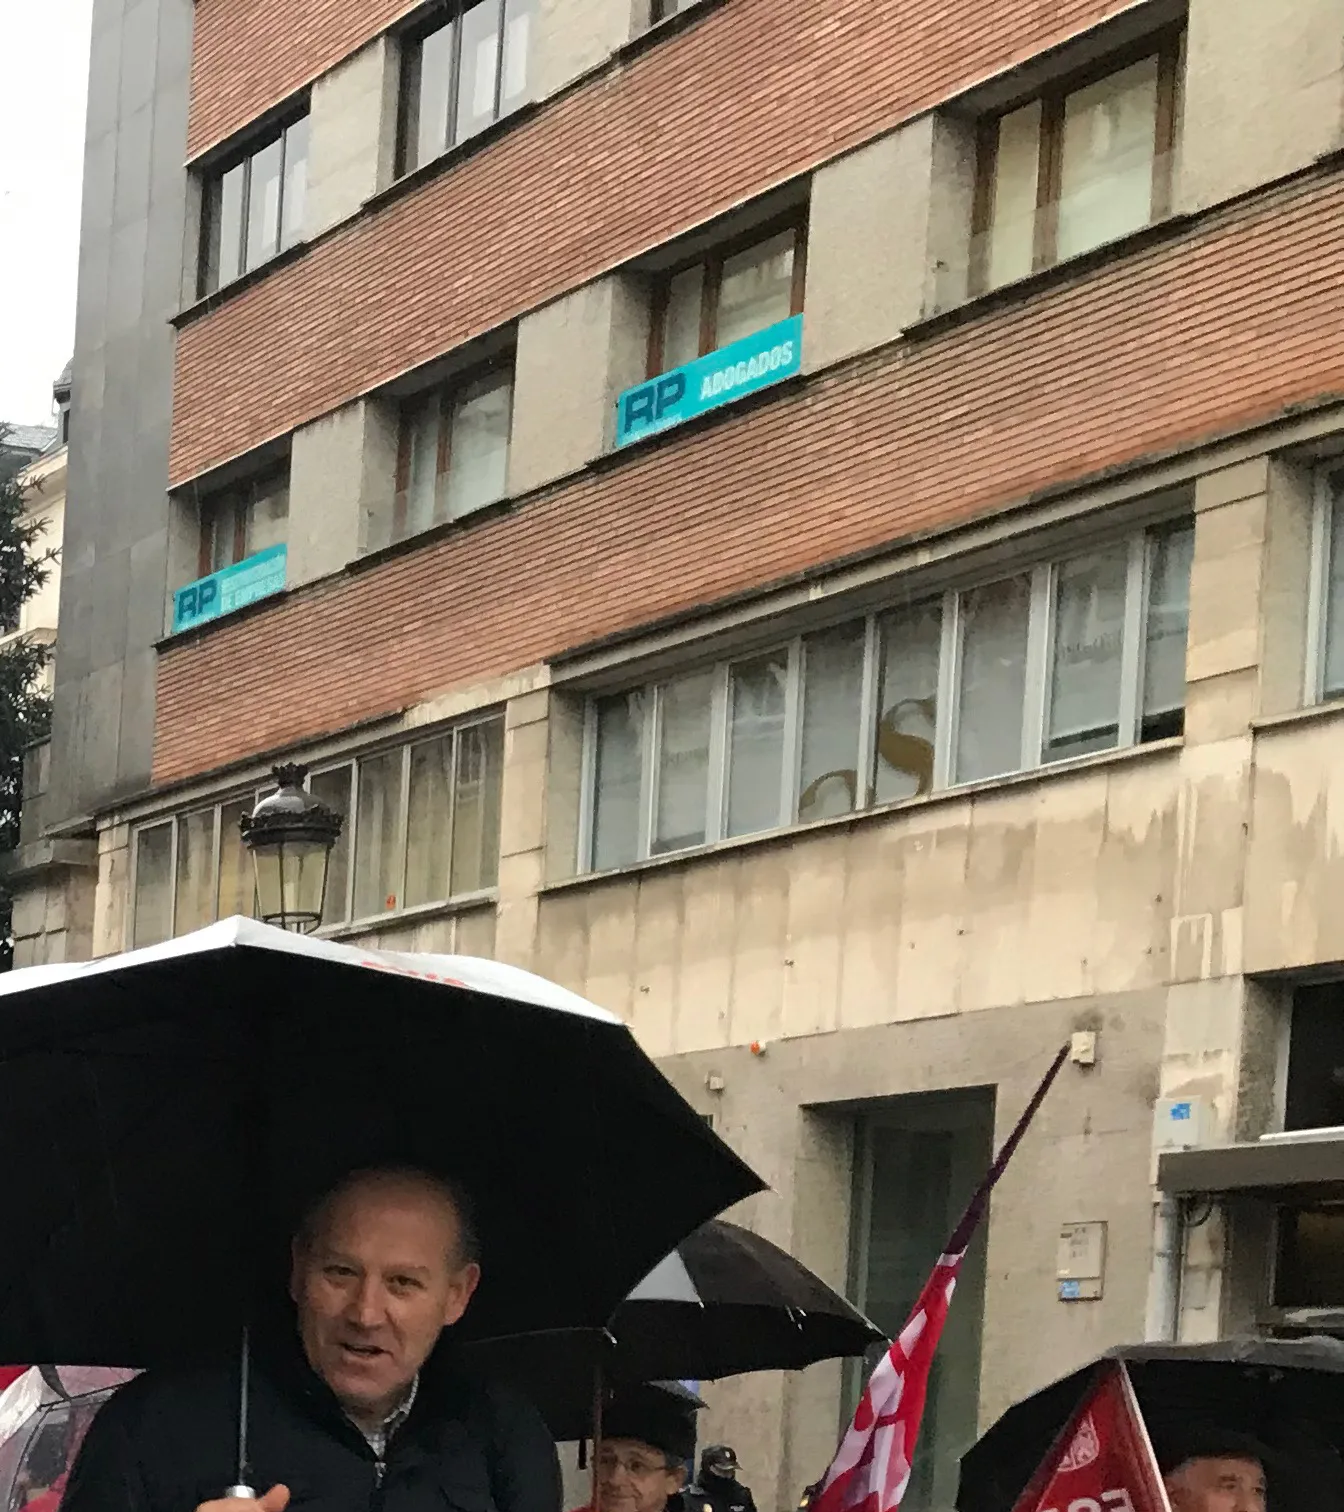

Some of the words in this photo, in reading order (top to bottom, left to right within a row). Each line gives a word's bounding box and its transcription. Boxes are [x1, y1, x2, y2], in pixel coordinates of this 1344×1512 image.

[624, 372, 686, 433] RP
[700, 341, 793, 400] ABOGADOS
[178, 579, 218, 621] RP
